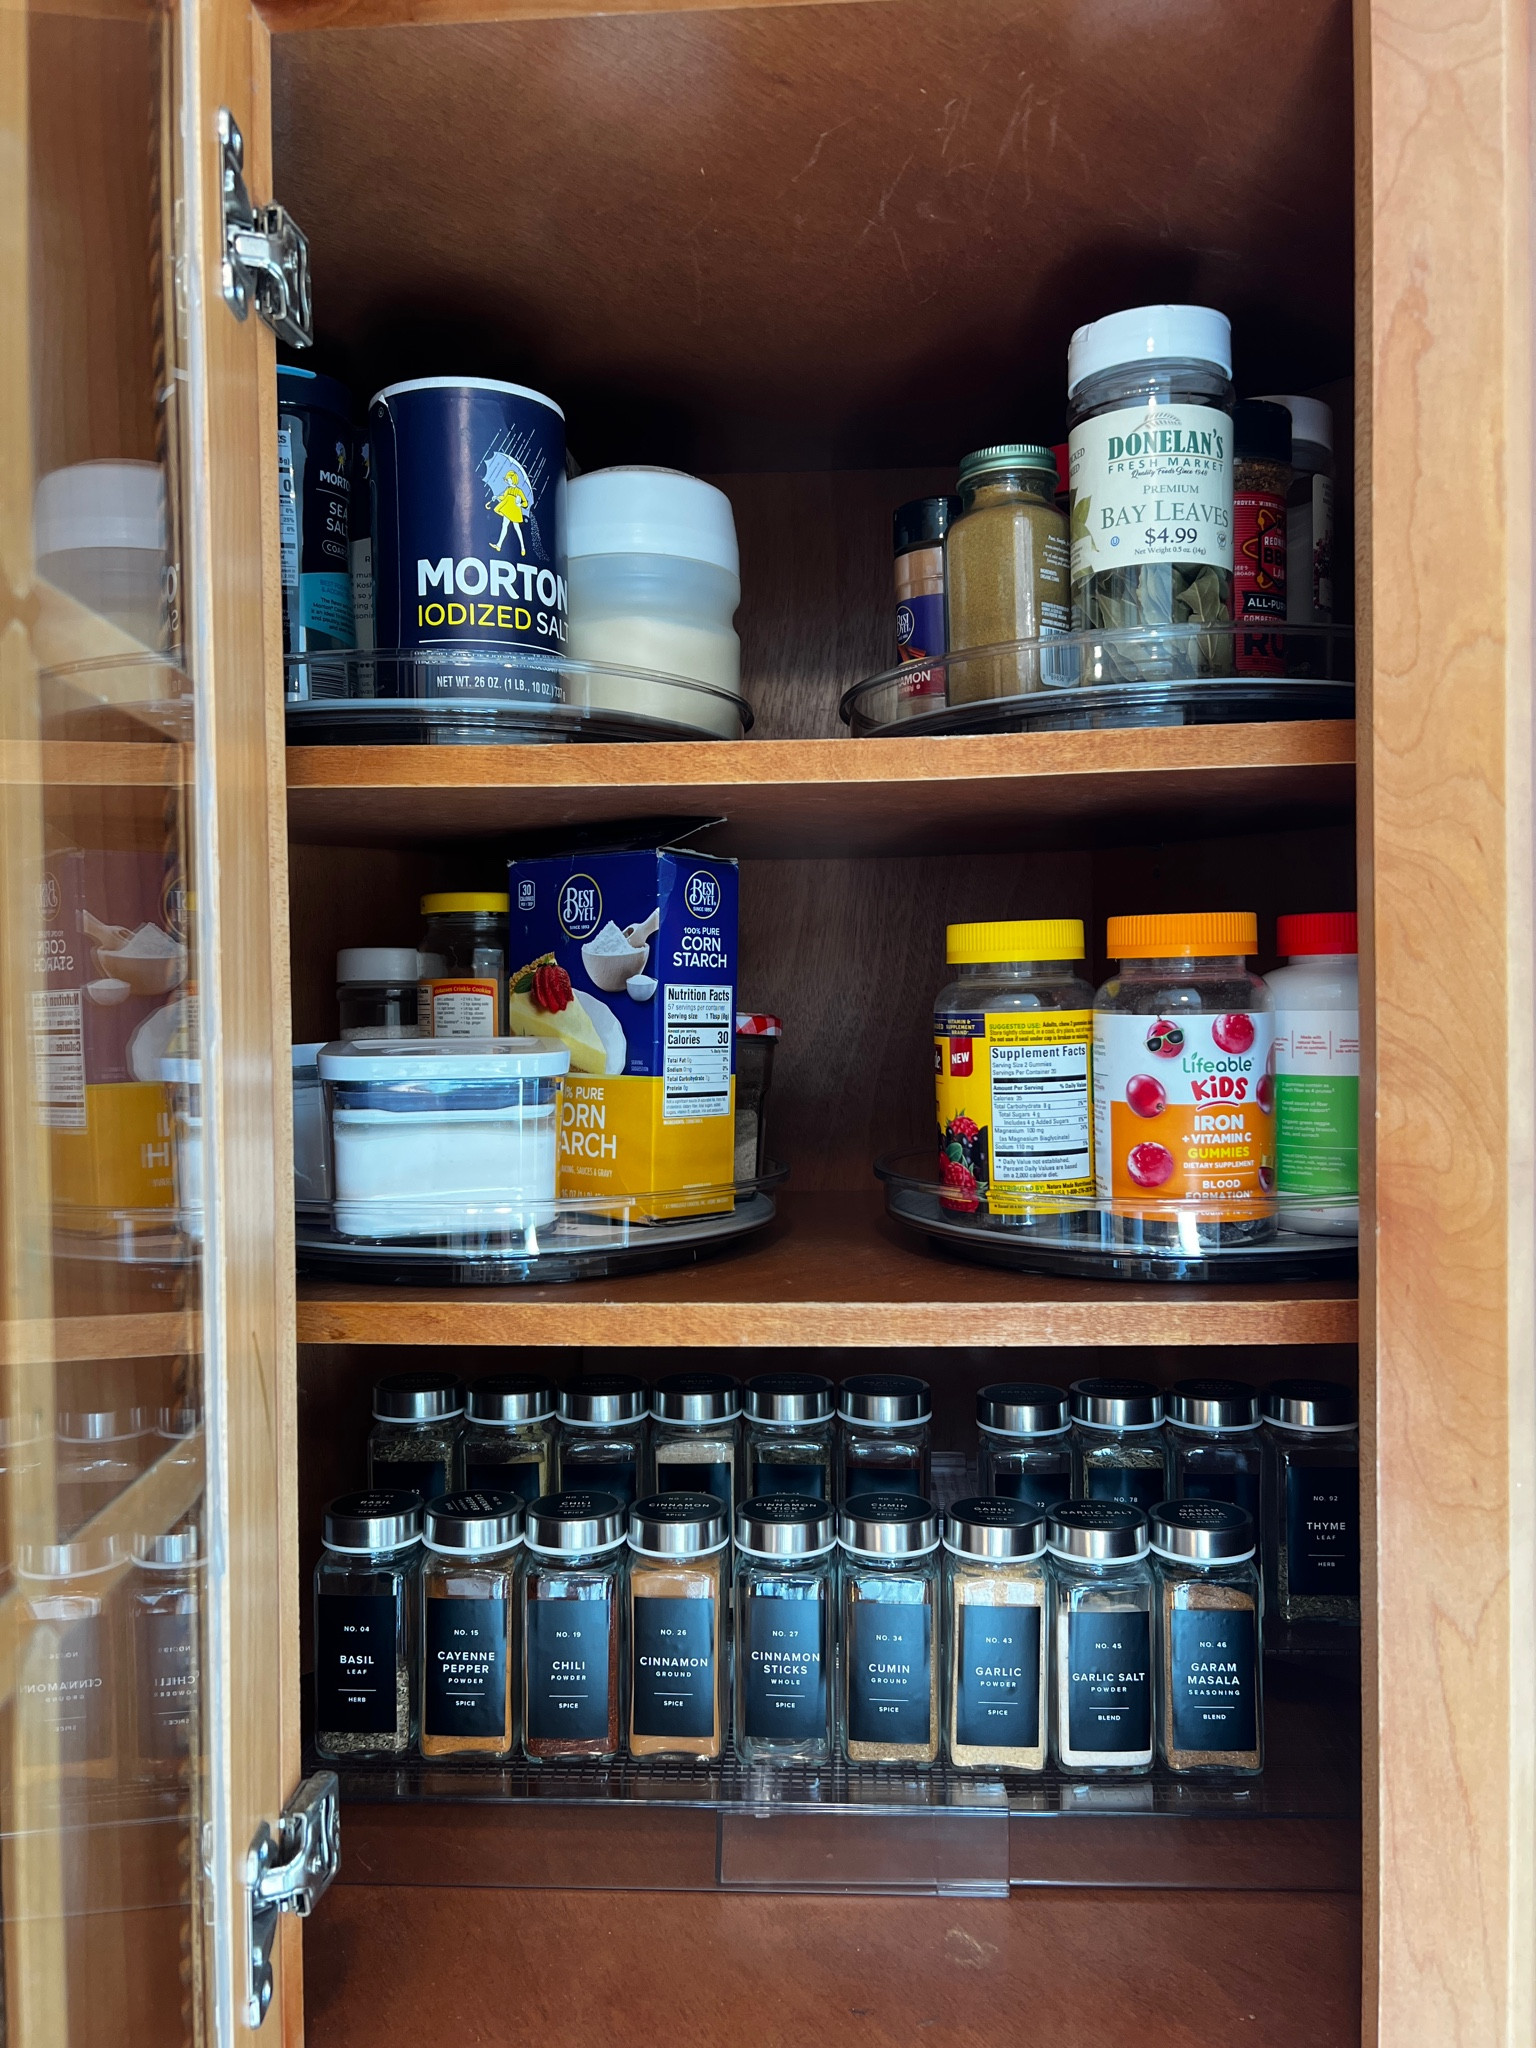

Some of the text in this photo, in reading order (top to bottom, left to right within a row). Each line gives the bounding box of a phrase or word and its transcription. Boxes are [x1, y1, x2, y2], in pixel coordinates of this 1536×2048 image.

[1108, 429, 1224, 460] DONELAN'S
[1109, 457, 1223, 474] FRESH MARKET
[1143, 485, 1199, 494] PREMIUM
[329, 501, 348, 520] SEA
[1101, 500, 1229, 529] BAY LEAVES
[1145, 527, 1197, 546] $4.99
[418, 557, 568, 615] MORTON
[419, 603, 532, 630] IODIZED
[437, 676, 453, 688] NET
[456, 676, 471, 688] WT.
[474, 676, 485, 688] 26
[488, 677, 501, 688] OZ.
[504, 678, 512, 692] (1
[515, 679, 529, 693] LB.,
[532, 682, 540, 693] 10
[522, 885, 531, 896] 30
[690, 878, 715, 905] BEST
[563, 888, 594, 922] BEST
[684, 927, 720, 935] 100% PURE
[682, 936, 721, 951] CORN
[673, 952, 727, 968] STARCH
[668, 988, 729, 1001] Nutrition Facts
[668, 1031, 728, 1044] Calories 30
[952, 1052, 970, 1064] NEW
[992, 1047, 1059, 1061] Supplement
[1063, 1046, 1086, 1056] Facts
[1183, 1053, 1252, 1073] Lifeable
[575, 1087, 604, 1100] PURE
[1194, 1114, 1244, 1131] IRON
[1191, 1133, 1243, 1144] VITAMIN
[1244, 1132, 1251, 1142] C
[1188, 1146, 1249, 1159] GUMMIES
[1215, 1160, 1254, 1168] SUPPLEMENT
[1203, 1179, 1240, 1189] BLOOD
[1306, 1522, 1346, 1531] THYME
[340, 1655, 374, 1664] BASIL
[437, 1651, 495, 1661] CAYENNE
[639, 1656, 708, 1667] CINNAMON
[751, 1651, 820, 1662] CINNAMON
[443, 1664, 489, 1674] PEPPER
[552, 1661, 585, 1670] CHILI
[763, 1664, 808, 1674] STICKS
[868, 1664, 910, 1674] CUMIN
[1190, 1663, 1237, 1672] GARAM
[975, 1667, 1022, 1677] GARLIC
[1072, 1673, 1145, 1681] GARLIC SALT
[1187, 1676, 1240, 1685] MASALA
